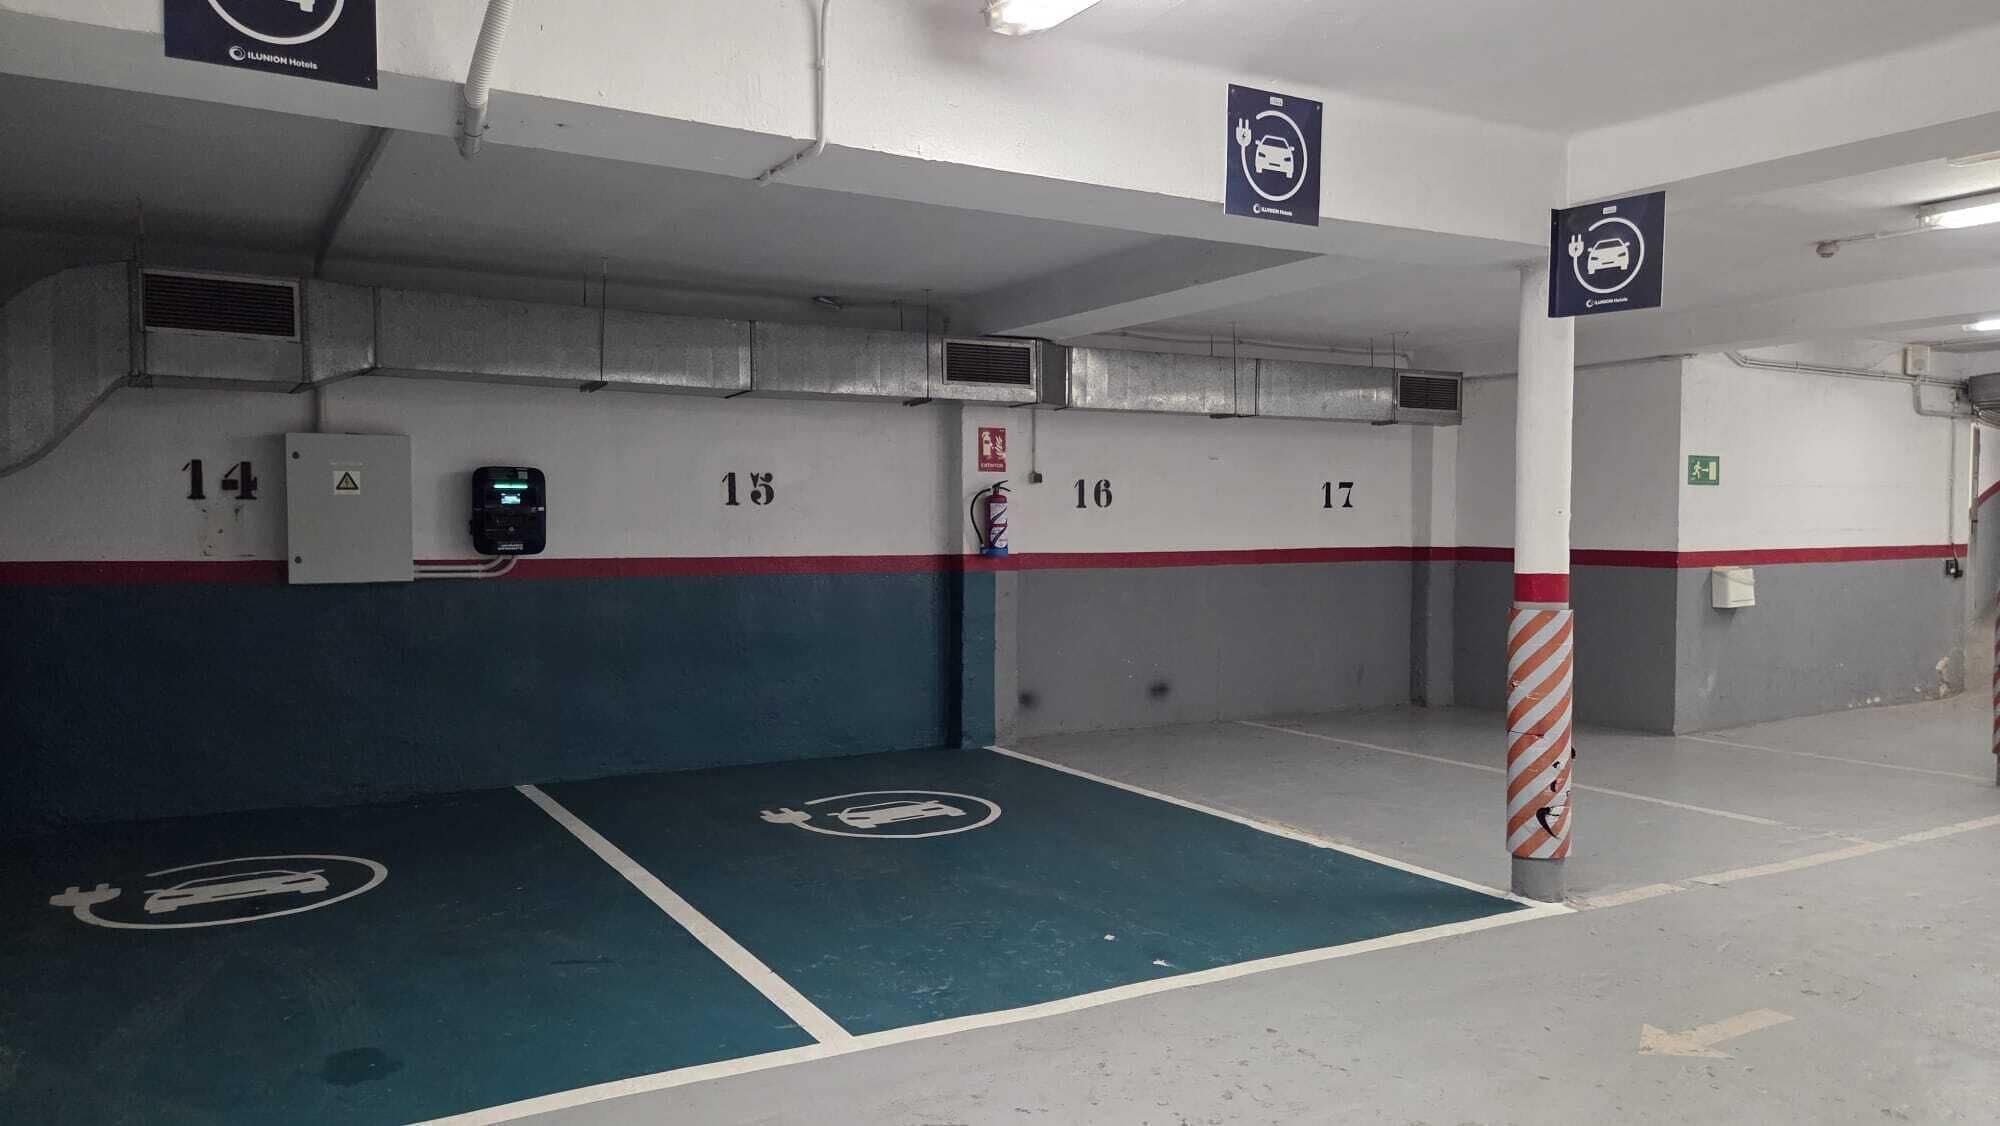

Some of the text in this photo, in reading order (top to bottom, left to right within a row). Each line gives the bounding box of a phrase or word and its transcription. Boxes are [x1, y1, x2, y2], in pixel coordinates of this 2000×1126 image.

[247, 51, 318, 69] ILUNION Hotels
[182, 459, 257, 500] 14
[721, 472, 774, 505] 15
[1074, 479, 1112, 508] 16
[1322, 481, 1353, 508] 17
